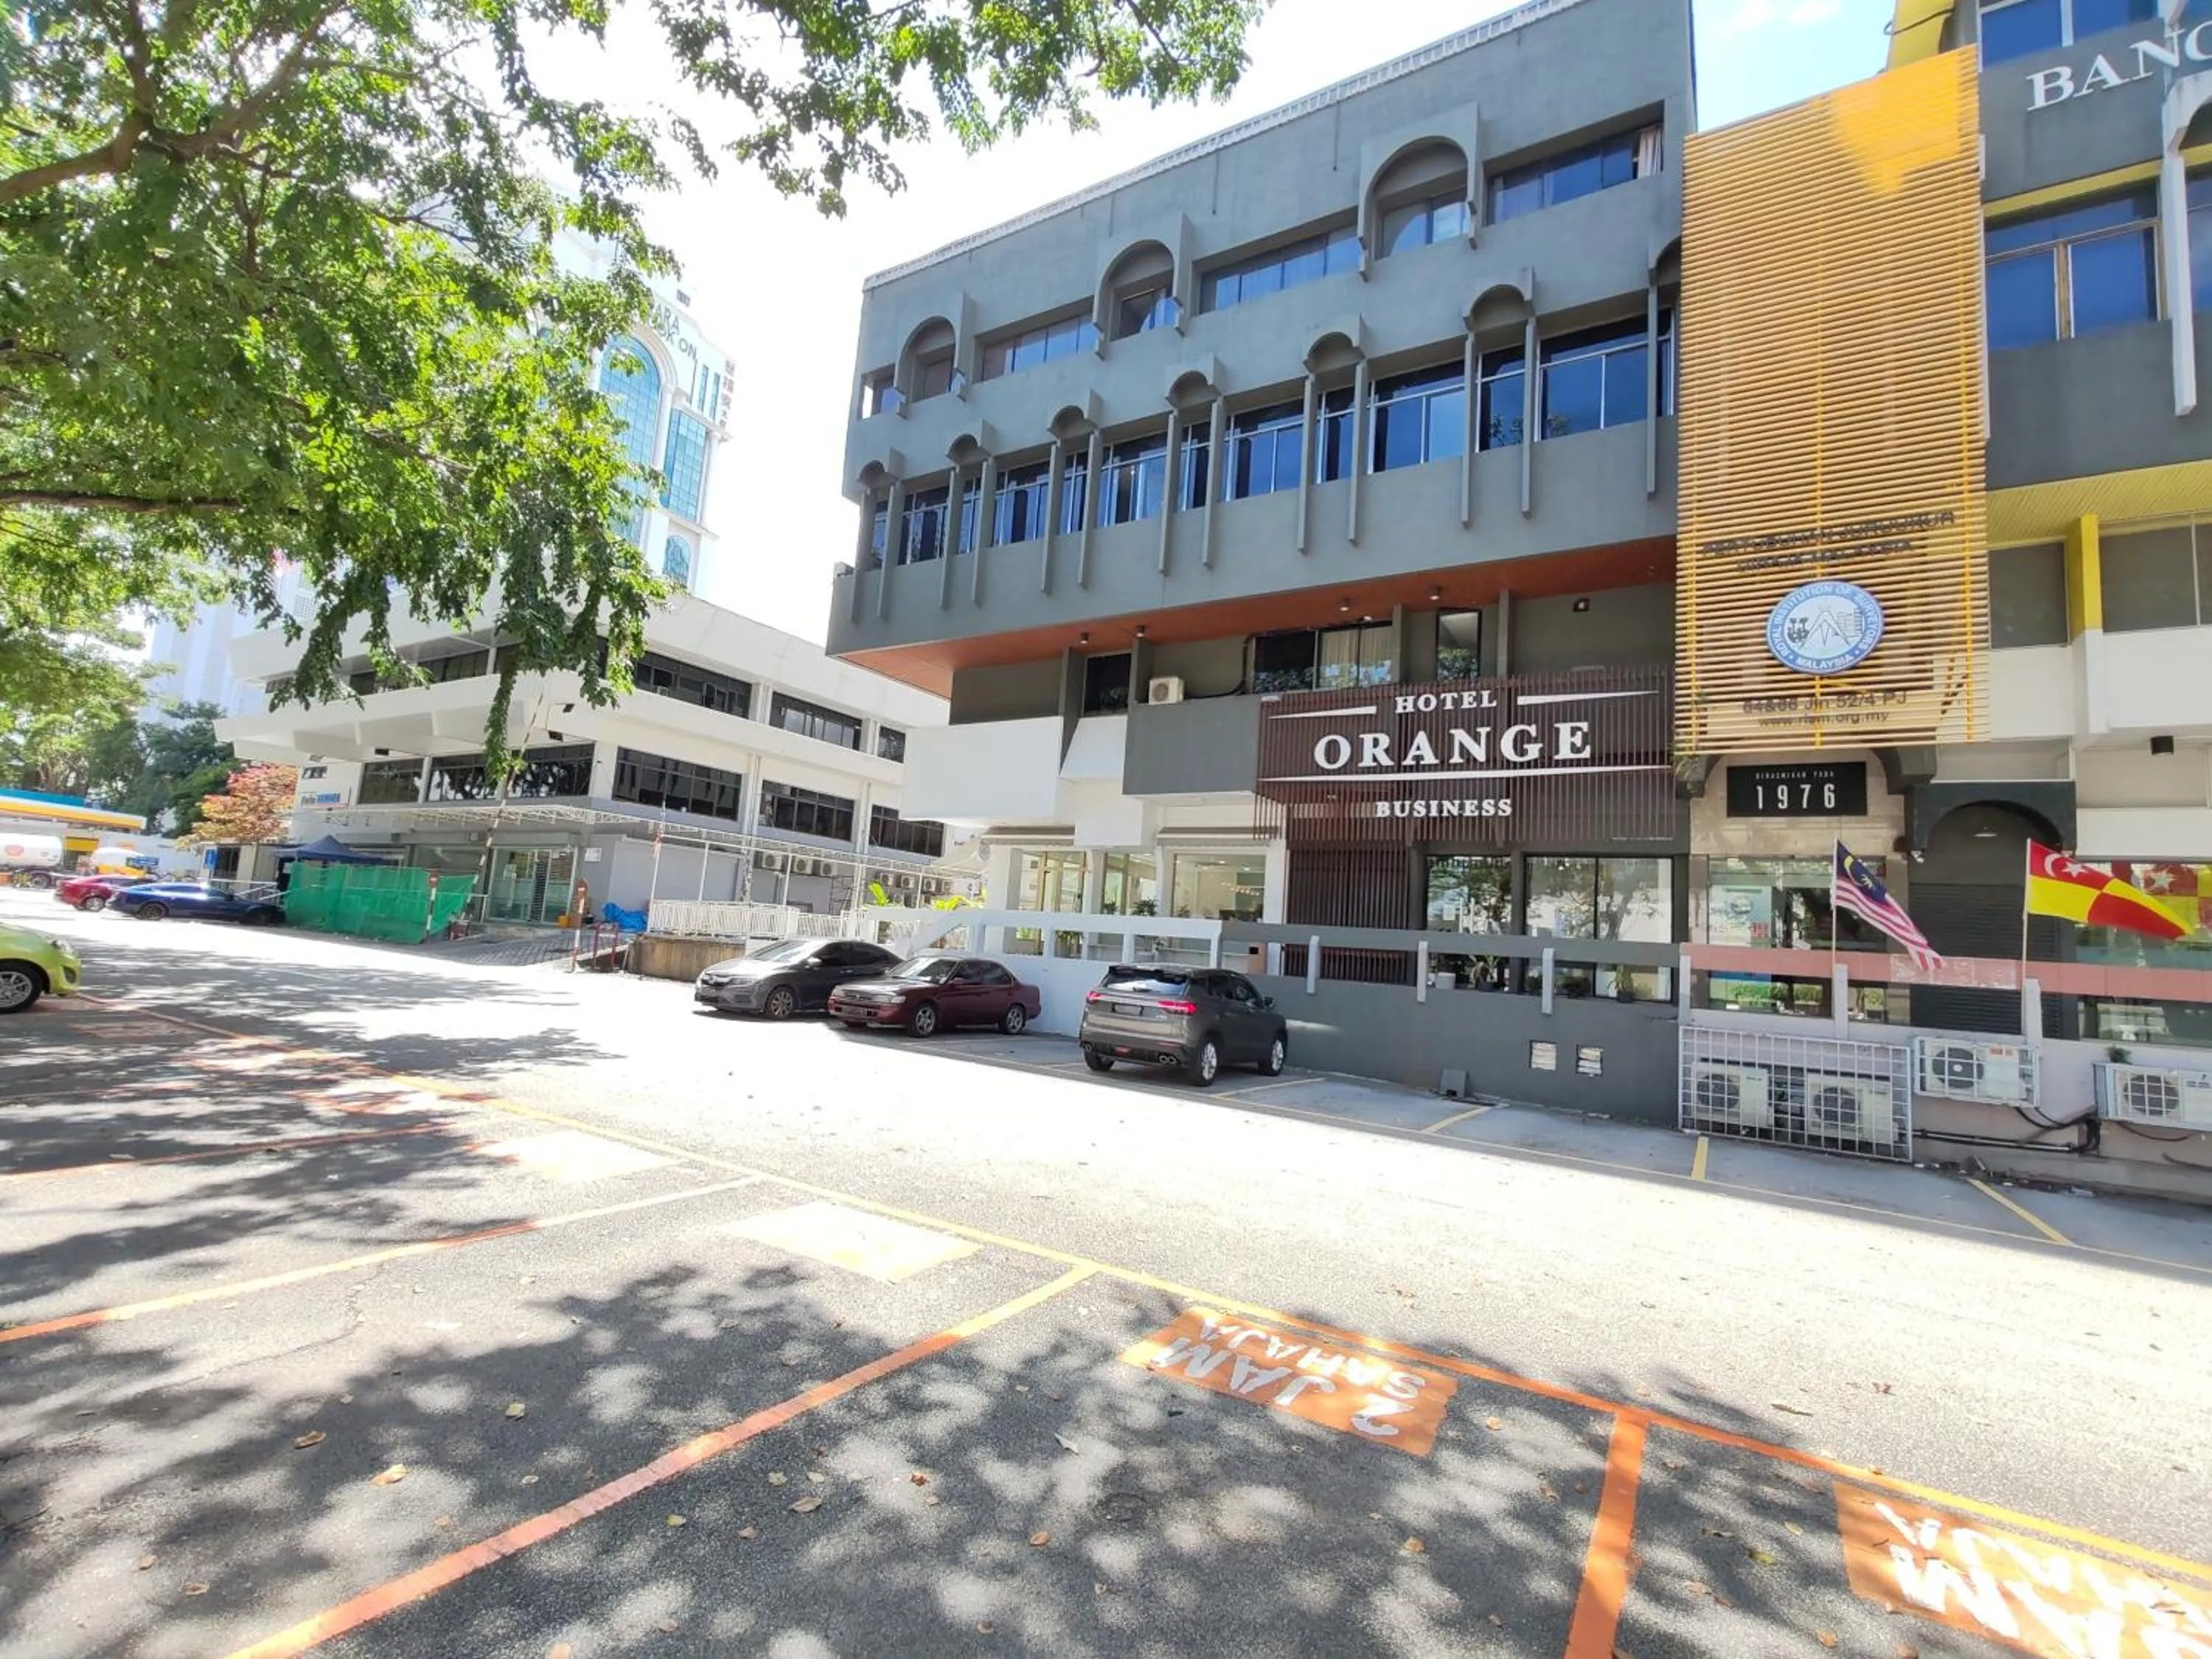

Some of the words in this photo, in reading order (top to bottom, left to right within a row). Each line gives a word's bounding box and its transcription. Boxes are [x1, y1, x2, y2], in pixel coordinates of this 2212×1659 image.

[1795, 654, 1854, 670] MALAYSIA
[1395, 690, 1498, 714] HOTEL
[1314, 722, 1591, 770] ORANGE
[1376, 799, 1513, 818] BUSINESS
[1756, 782, 1836, 810] 1976
[1151, 1337, 1336, 1406] JAM
[1199, 1315, 1427, 1399] SAHAJA
[1351, 1394, 1415, 1436] 2
